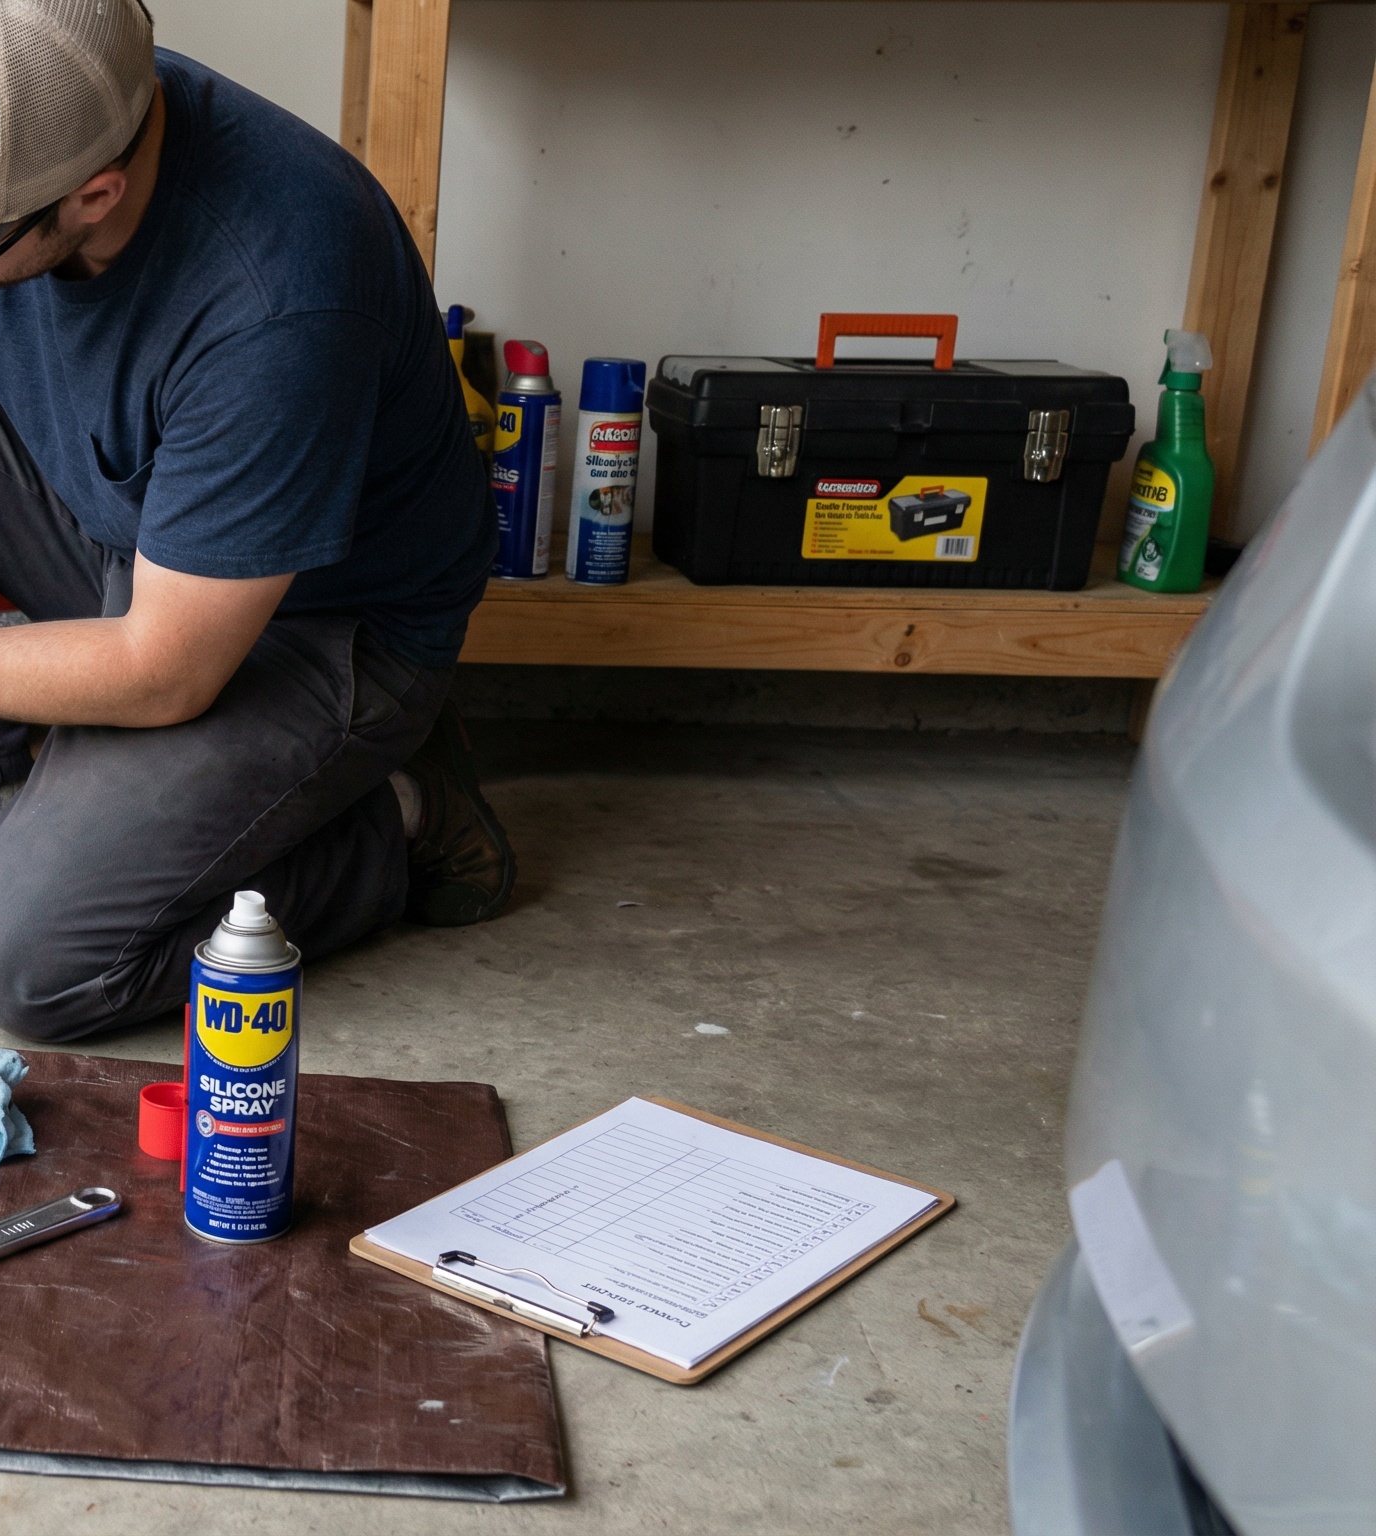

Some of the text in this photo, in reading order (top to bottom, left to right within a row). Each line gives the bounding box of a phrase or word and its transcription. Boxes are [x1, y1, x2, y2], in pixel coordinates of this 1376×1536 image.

[499, 411, 516, 432] 40
[203, 995, 287, 1034] WD-40
[199, 1074, 286, 1099] SILICONE
[209, 1096, 274, 1115] SPRAY
